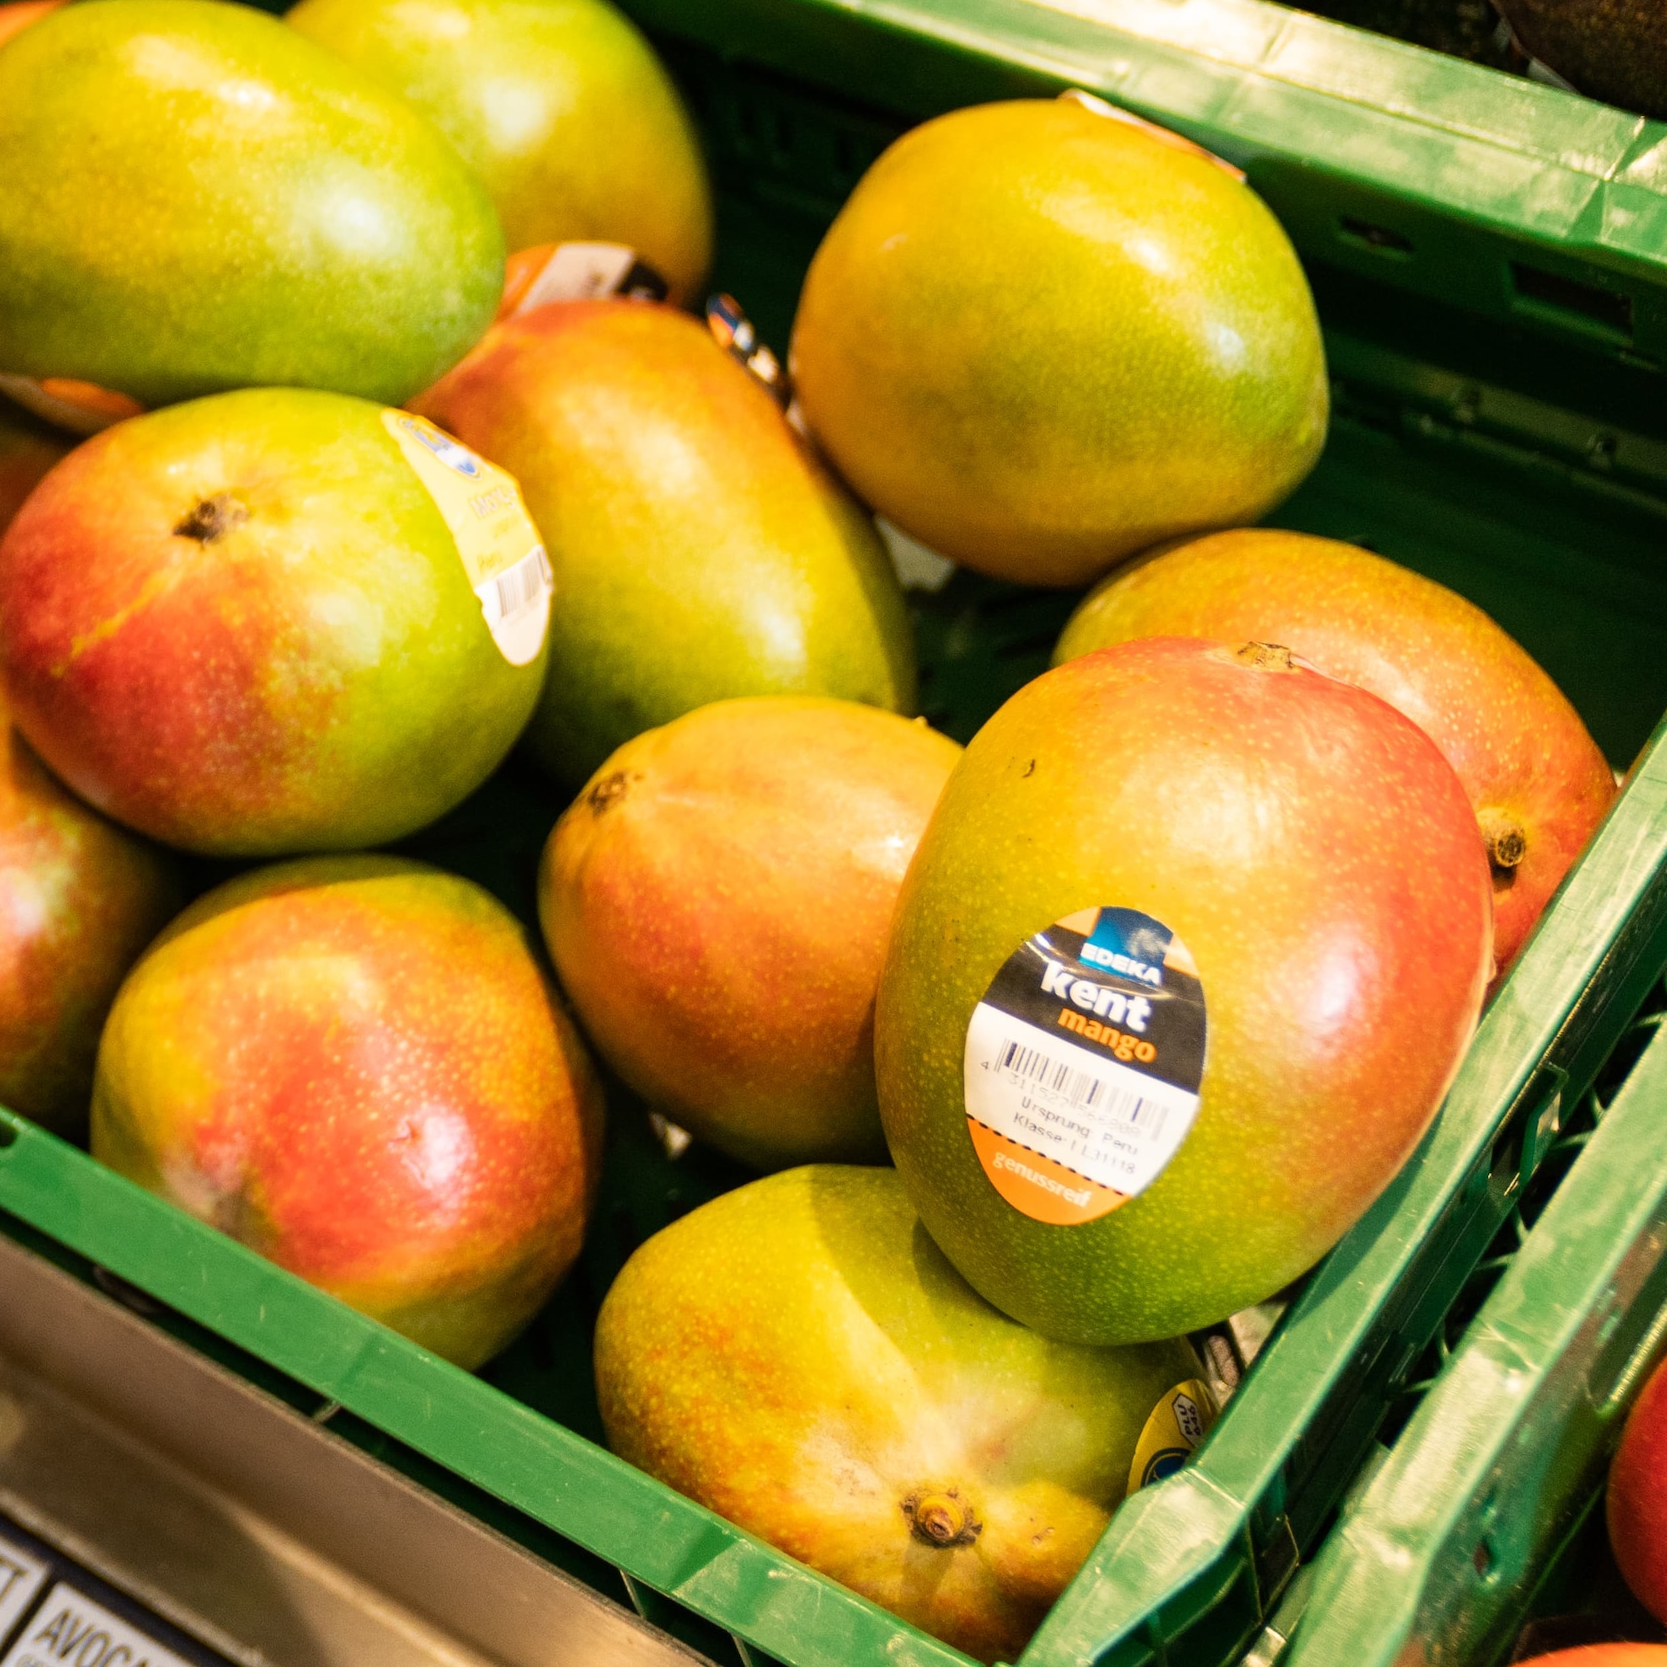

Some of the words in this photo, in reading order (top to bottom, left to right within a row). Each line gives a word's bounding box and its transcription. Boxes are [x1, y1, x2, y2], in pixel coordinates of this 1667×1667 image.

[1080, 941, 1162, 986] EDEKA
[1040, 959, 1152, 1033] kent
[1057, 1007, 1158, 1064] mango
[980, 1060, 990, 1071] 4
[992, 1151, 1093, 1208] genussreif
[1177, 1404, 1194, 1437] PLU
